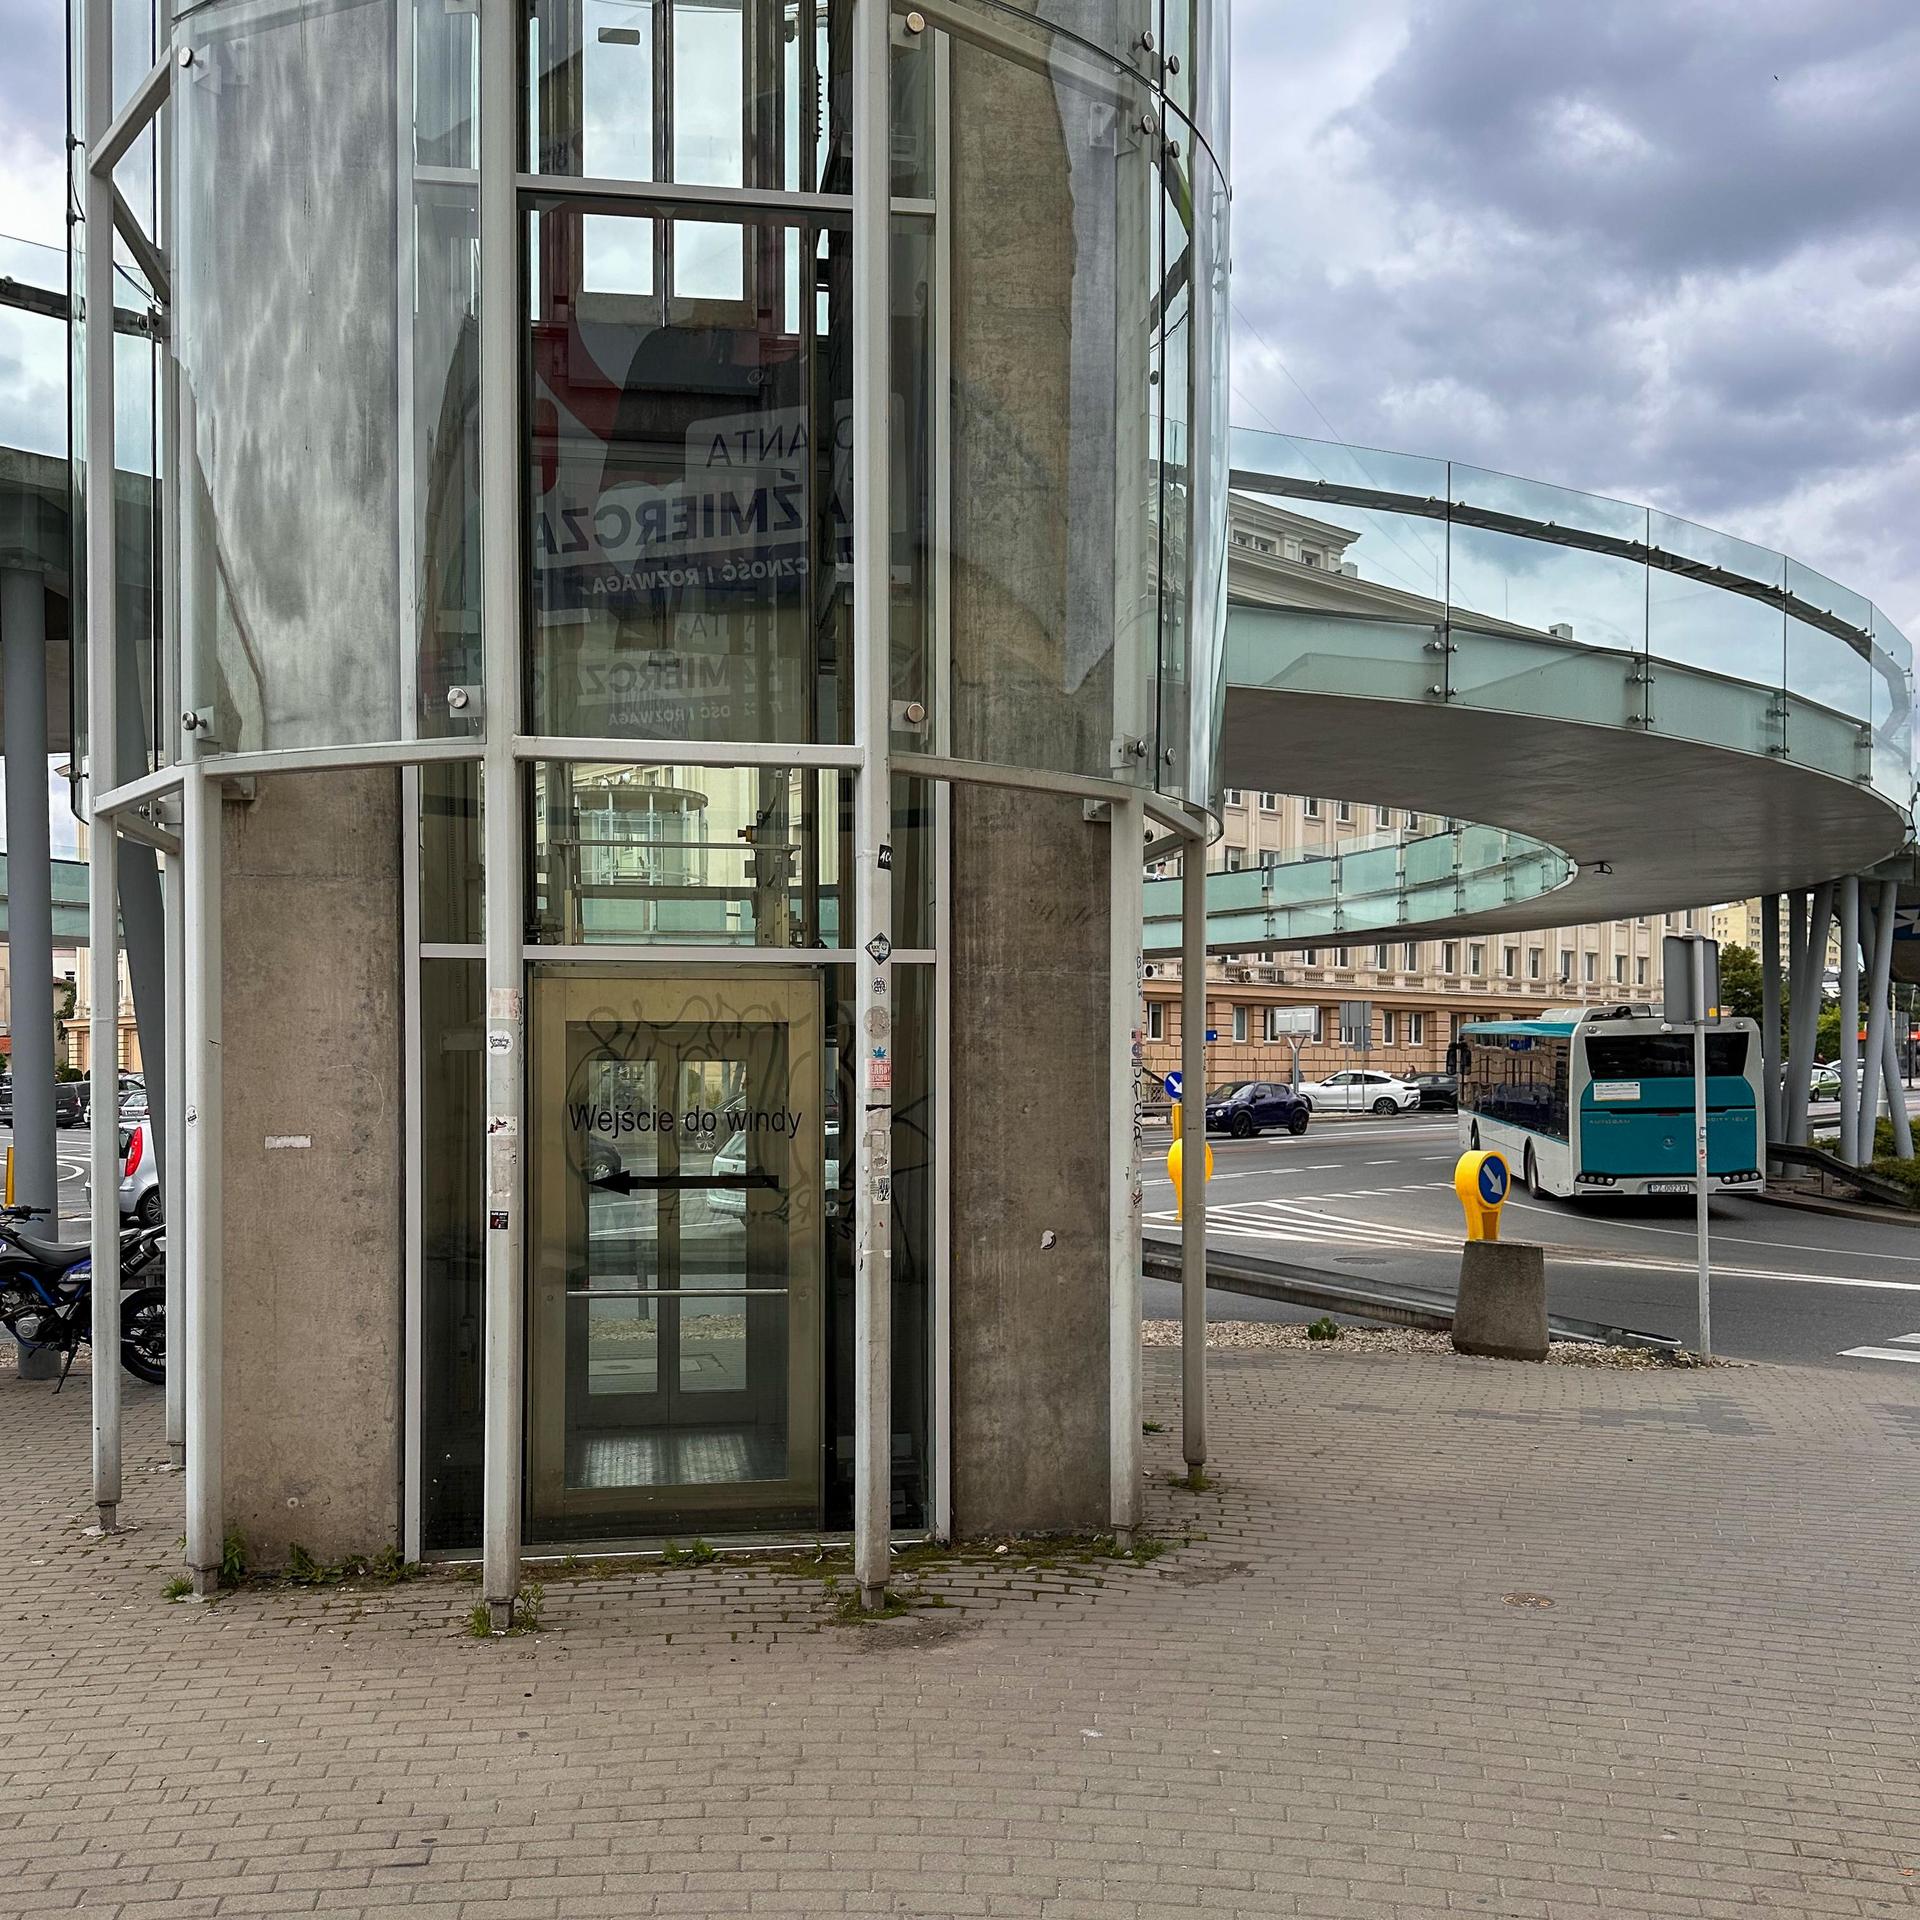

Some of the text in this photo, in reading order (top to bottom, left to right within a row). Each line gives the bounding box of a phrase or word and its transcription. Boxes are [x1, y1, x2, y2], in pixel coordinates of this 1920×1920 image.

[568, 1103, 802, 1139] Wejście do windy
